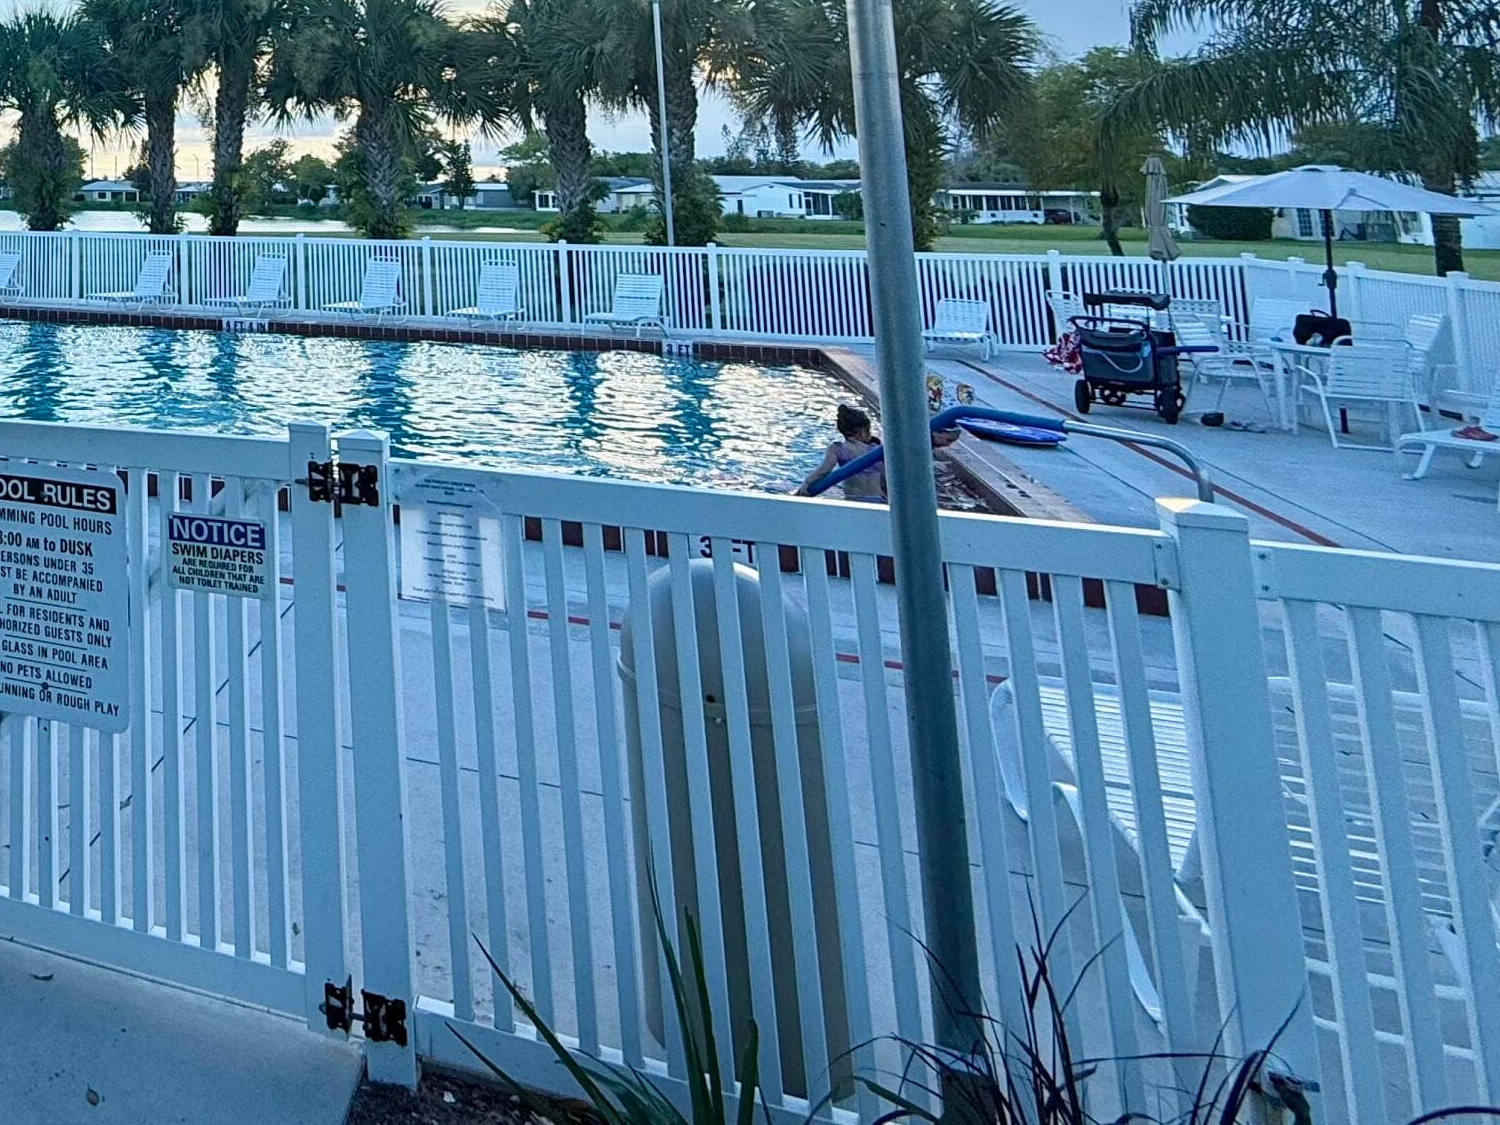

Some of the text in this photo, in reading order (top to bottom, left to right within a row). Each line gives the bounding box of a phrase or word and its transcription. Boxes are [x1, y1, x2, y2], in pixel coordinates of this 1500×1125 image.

[678, 344, 690, 357] FT
[43, 483, 111, 510] RULES
[40, 512, 69, 529] POOL
[73, 517, 112, 535] HOURS
[172, 517, 261, 547] NOTICE
[26, 537, 40, 549] AM
[44, 537, 56, 552] to
[60, 538, 93, 557] DUSK
[172, 542, 264, 565] SWIM DIAPERS
[700, 536, 713, 558] 3
[43, 556, 76, 573] UNDER
[82, 561, 94, 575] 35
[172, 565, 265, 585] ALL CHILDREN THAT ARE
[182, 557, 254, 574] ARE REQUIRED FOR
[15, 567, 28, 581] BE
[32, 570, 103, 593] ACCOMPANIED
[179, 575, 259, 594] NOT TOILET TRAINED
[13, 583, 78, 604] BY AN ADULT
[7, 603, 25, 618] FOR
[29, 607, 84, 628] RESIDENTS
[89, 617, 110, 632] AND
[44, 625, 83, 643] GUESTS
[87, 633, 112, 648] ONLY
[2, 639, 34, 655] GLASS
[38, 646, 48, 658] IN
[52, 649, 77, 664] POOL
[81, 654, 108, 670] AREA
[0, 660, 92, 689] NO PETS ALLOWED
[39, 689, 52, 704] OR
[57, 693, 90, 711] ROUGH
[94, 700, 119, 717] PLAY
